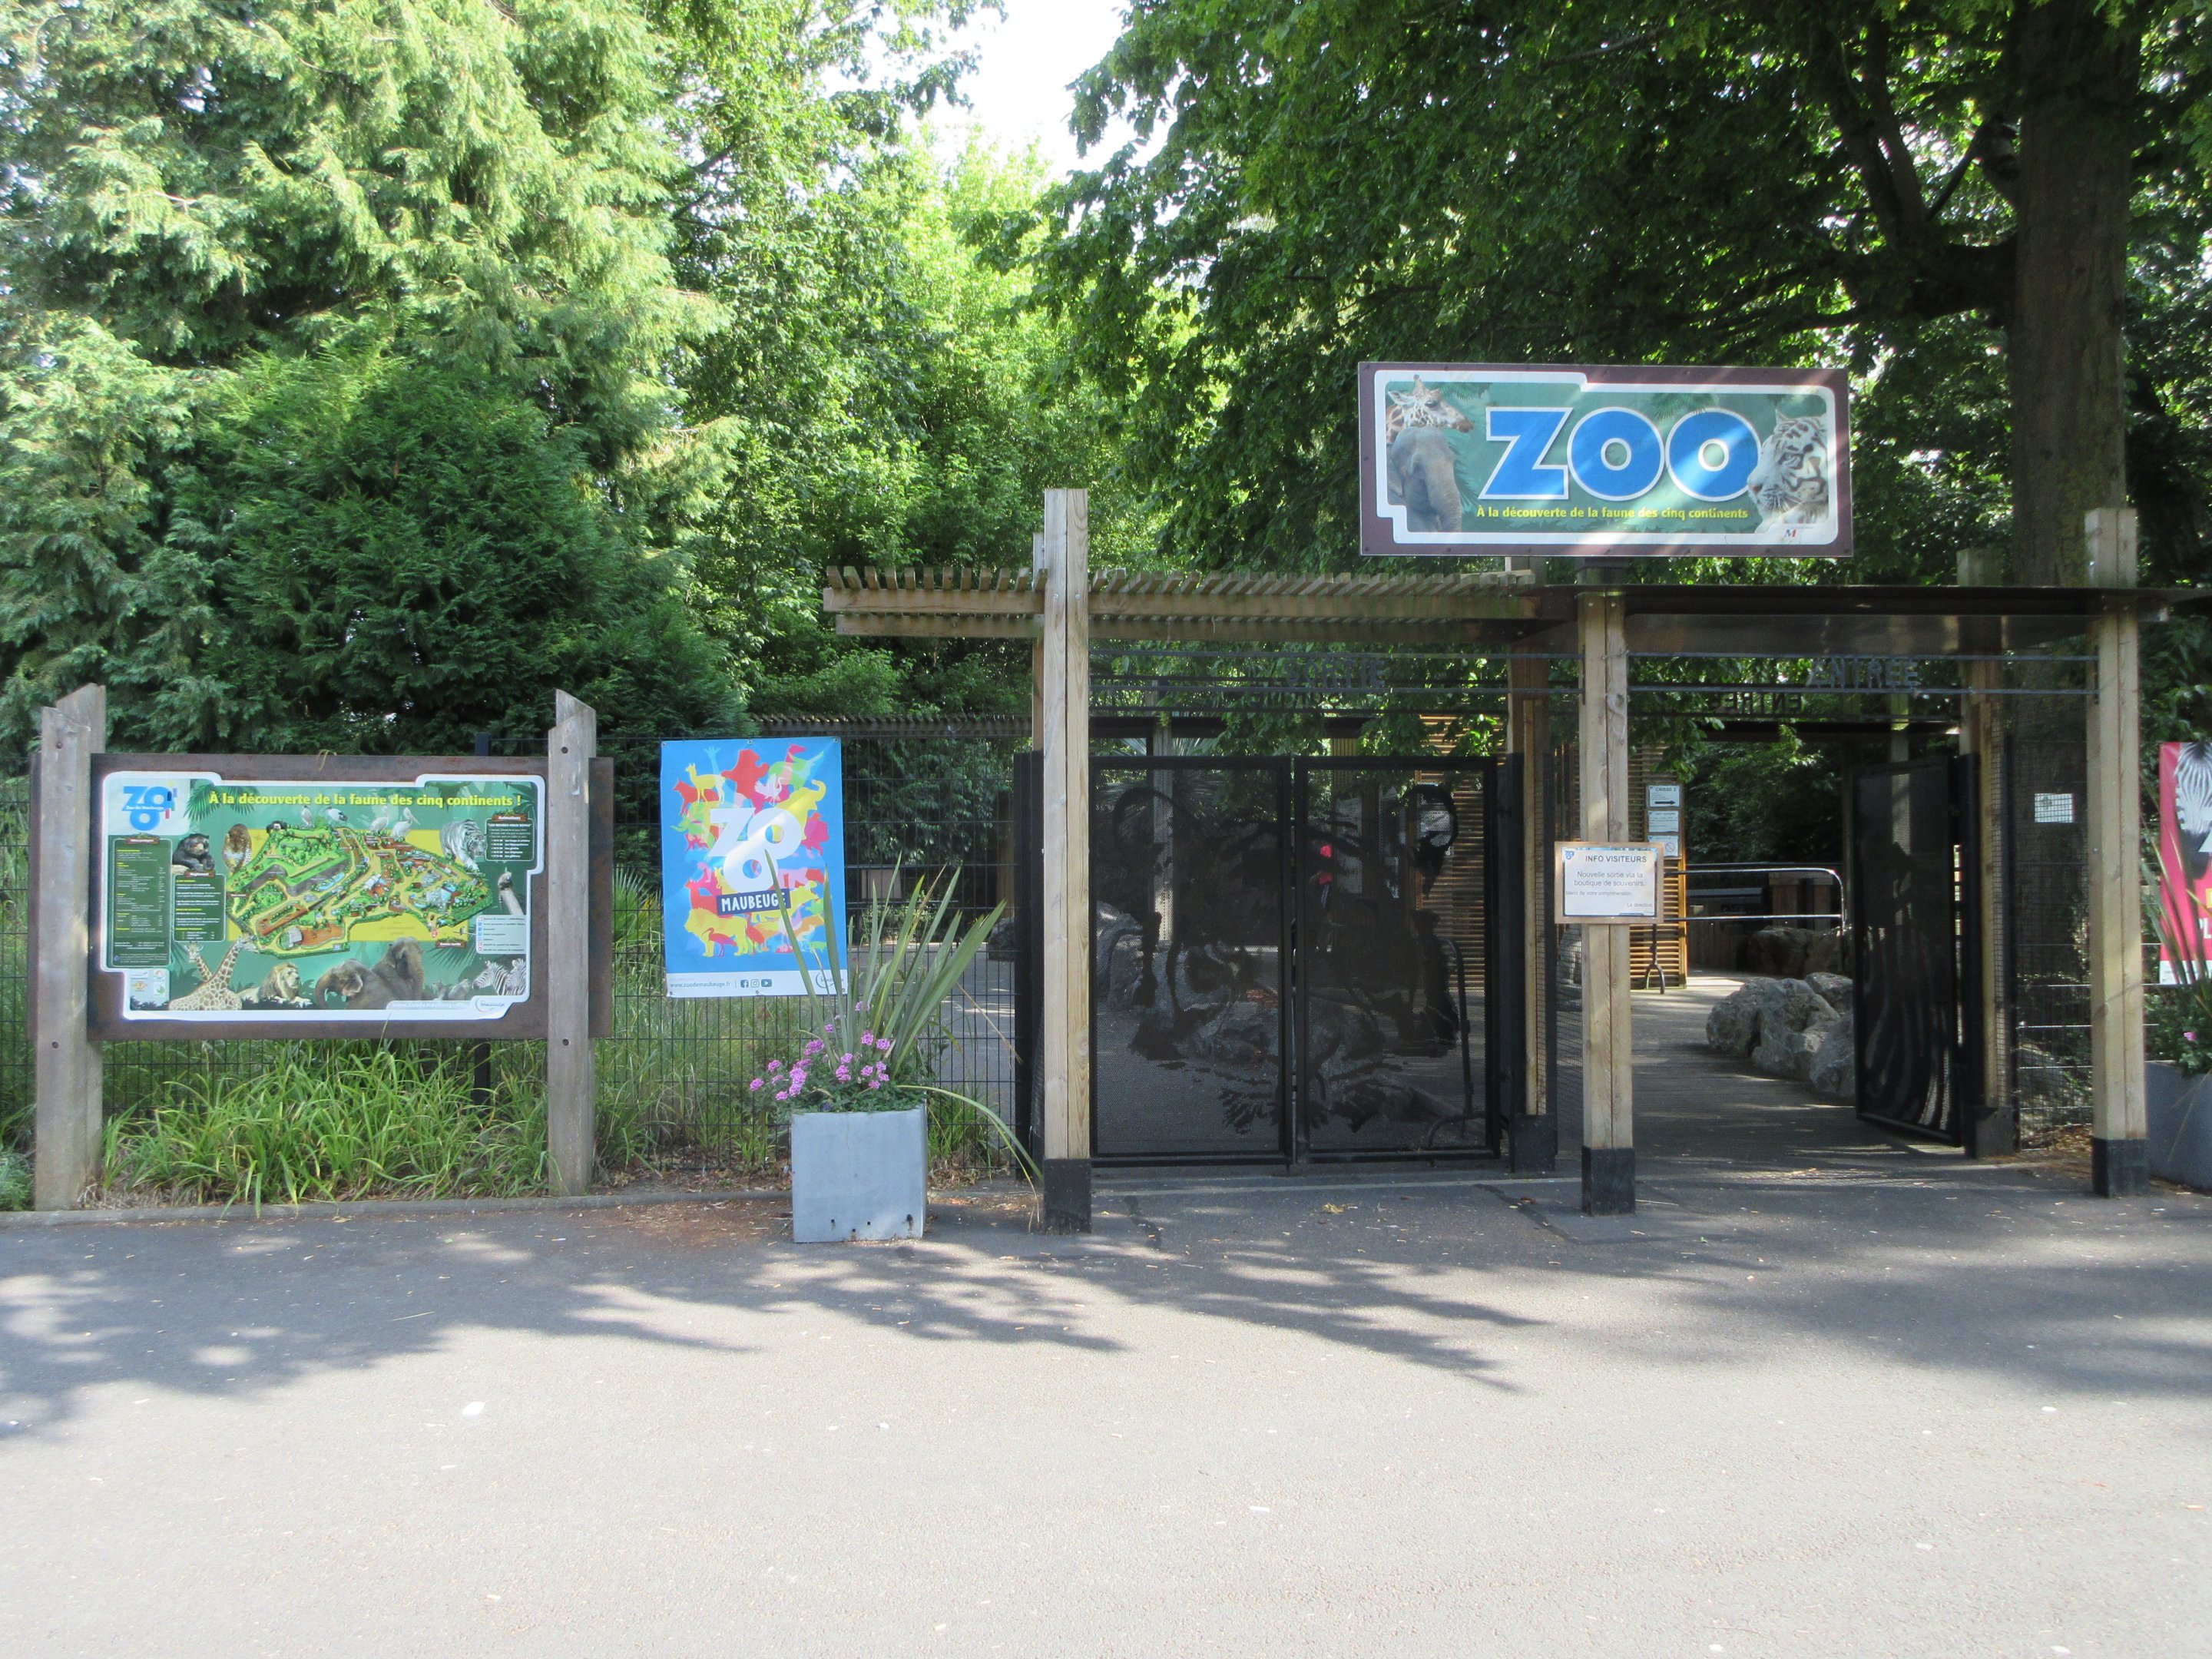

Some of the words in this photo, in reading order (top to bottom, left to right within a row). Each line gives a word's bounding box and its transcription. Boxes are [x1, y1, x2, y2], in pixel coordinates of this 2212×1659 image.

[1479, 406, 1763, 502] ZOO
[1477, 505, 1485, 518] À
[1488, 506, 1498, 518] la
[1502, 506, 1567, 518] découverte
[1570, 506, 1584, 518] de
[1588, 506, 1598, 518] la
[1601, 506, 1635, 518] faune
[1637, 507, 1657, 518] des
[1661, 507, 1685, 521] cinq
[1688, 507, 1748, 519] continents
[1285, 658, 1386, 688] SORTIE
[208, 791, 219, 804] À
[223, 793, 235, 804] la
[239, 792, 310, 805] découverte
[314, 793, 330, 805] de
[334, 793, 346, 805] la
[349, 793, 386, 806] faune
[390, 794, 412, 805] des
[416, 794, 443, 809] cinq
[447, 795, 513, 806] continents
[517, 794, 522, 806] !
[1606, 855, 1647, 863] VISITEURS
